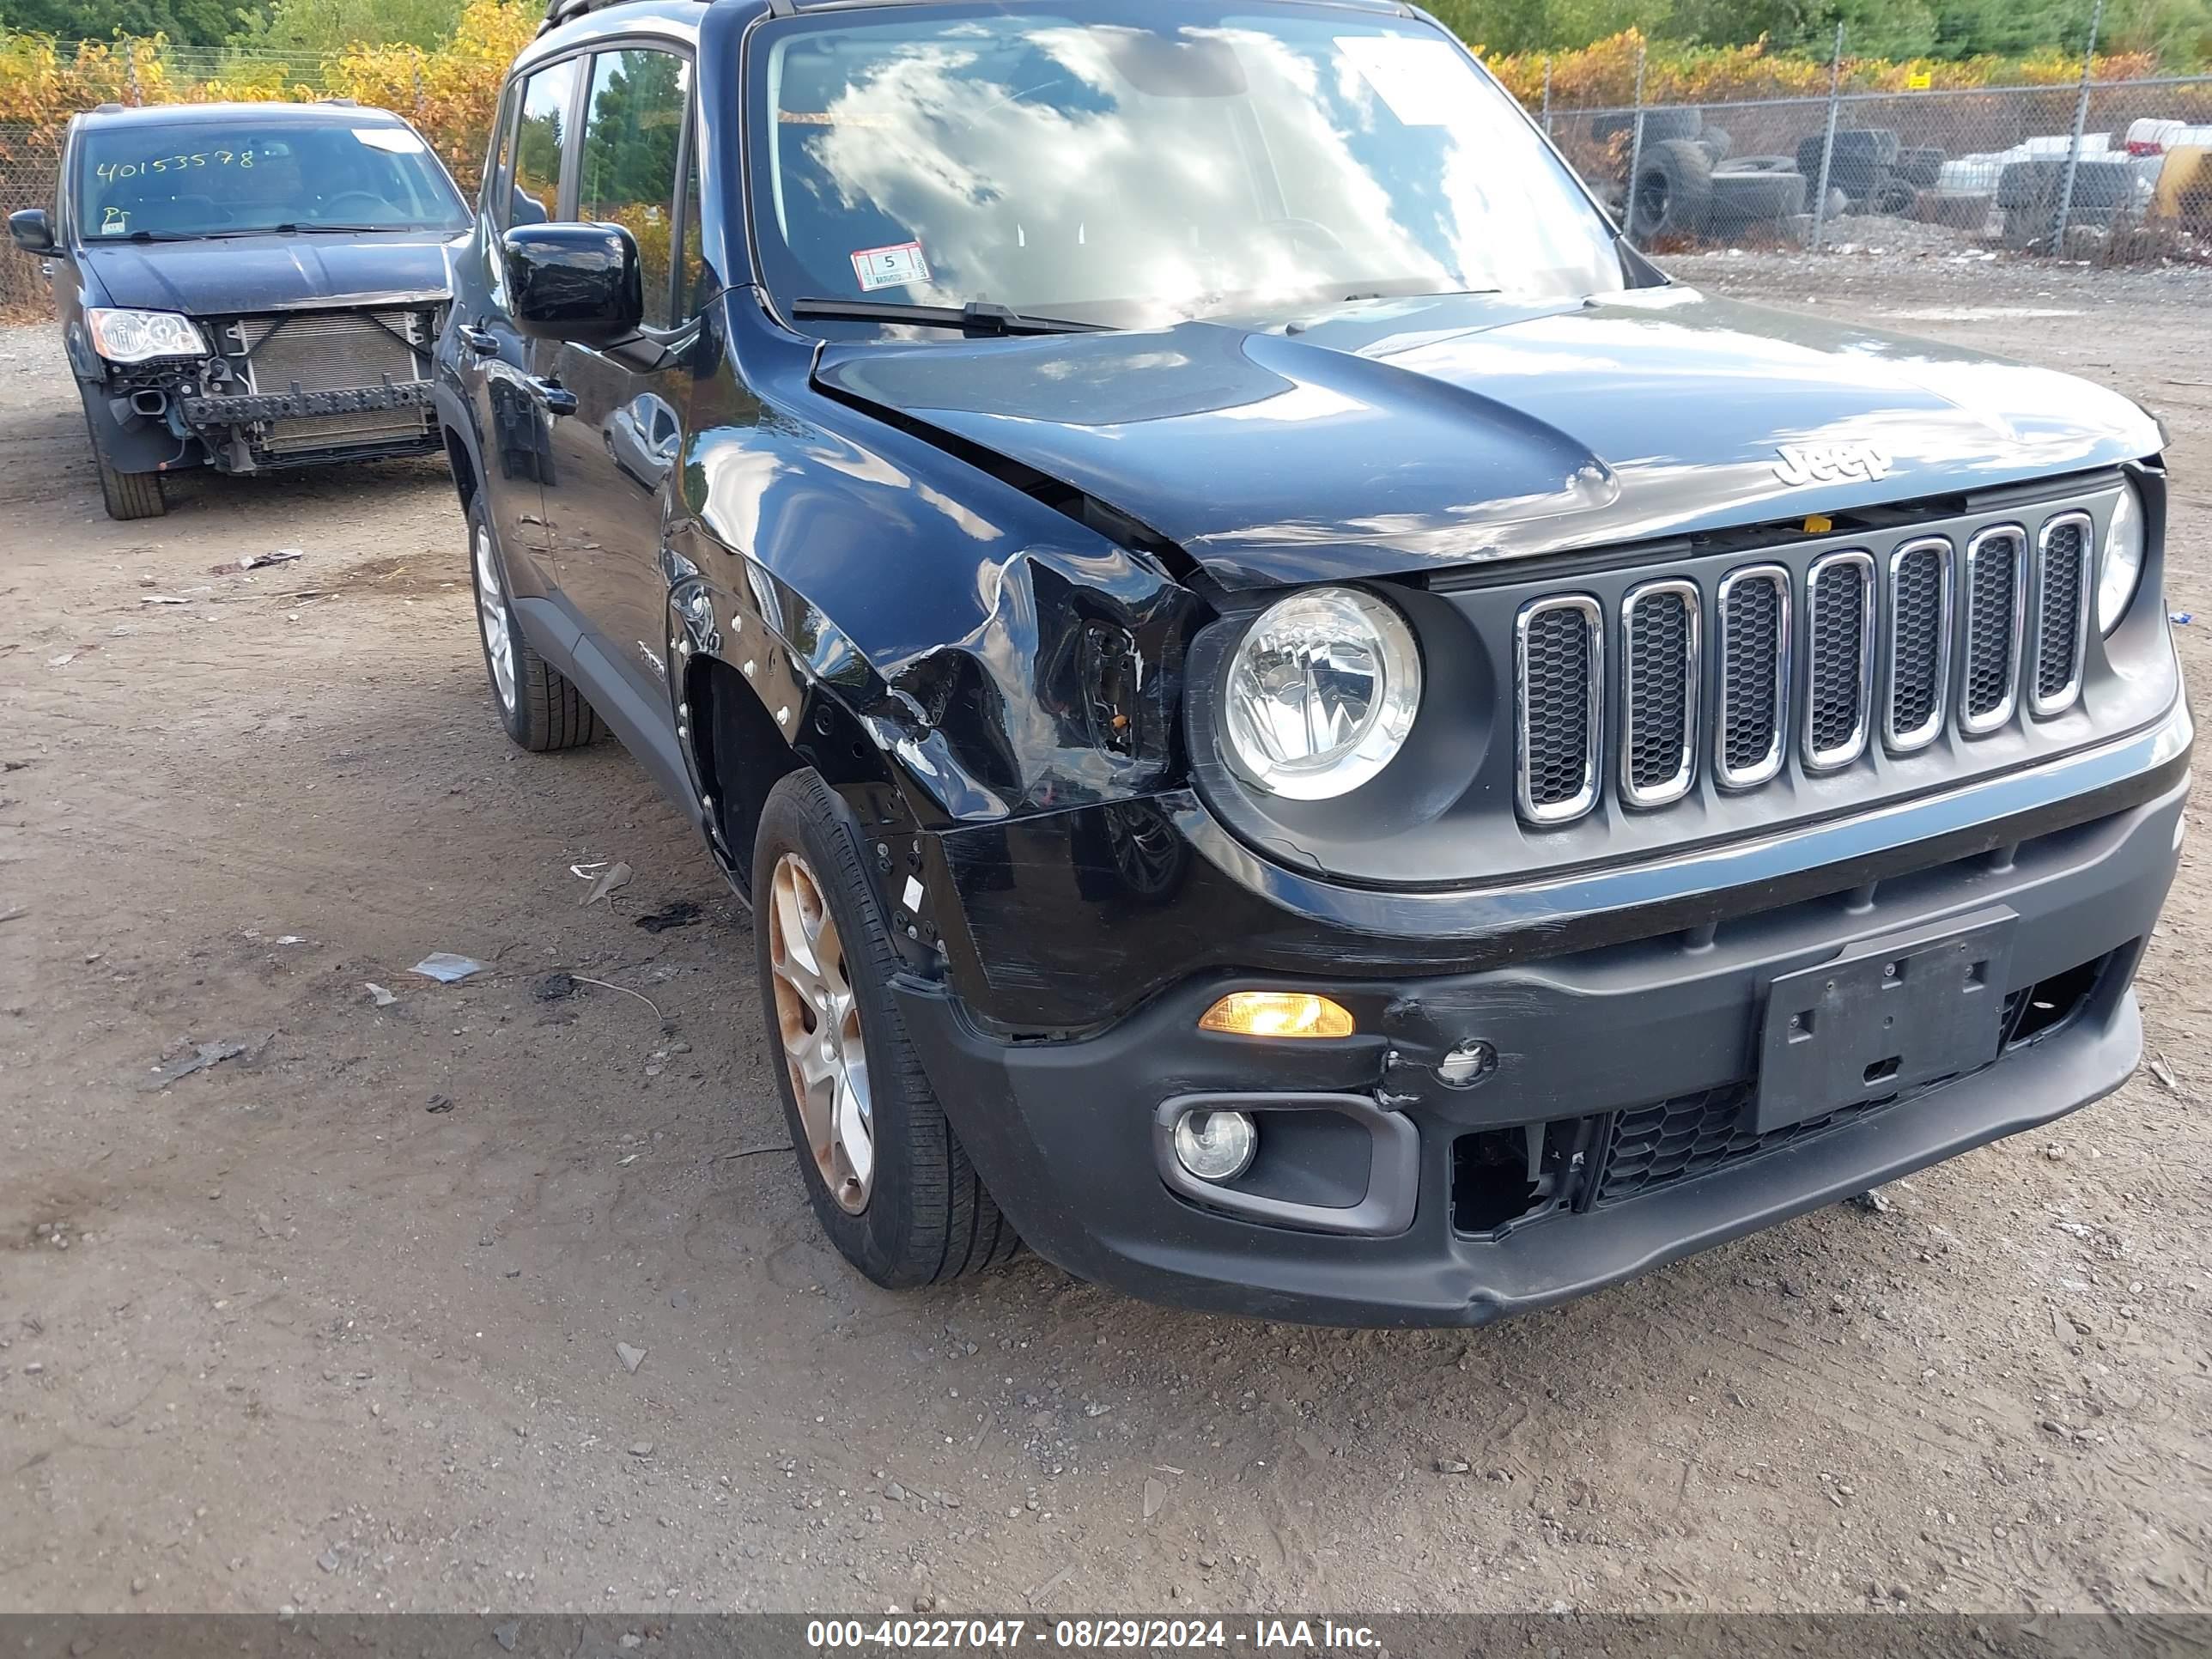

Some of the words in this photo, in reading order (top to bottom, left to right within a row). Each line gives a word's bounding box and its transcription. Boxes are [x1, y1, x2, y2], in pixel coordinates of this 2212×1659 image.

[96, 150, 254, 183] 40153578
[884, 255, 896, 268] 5
[1771, 445, 1893, 487] Jeep
